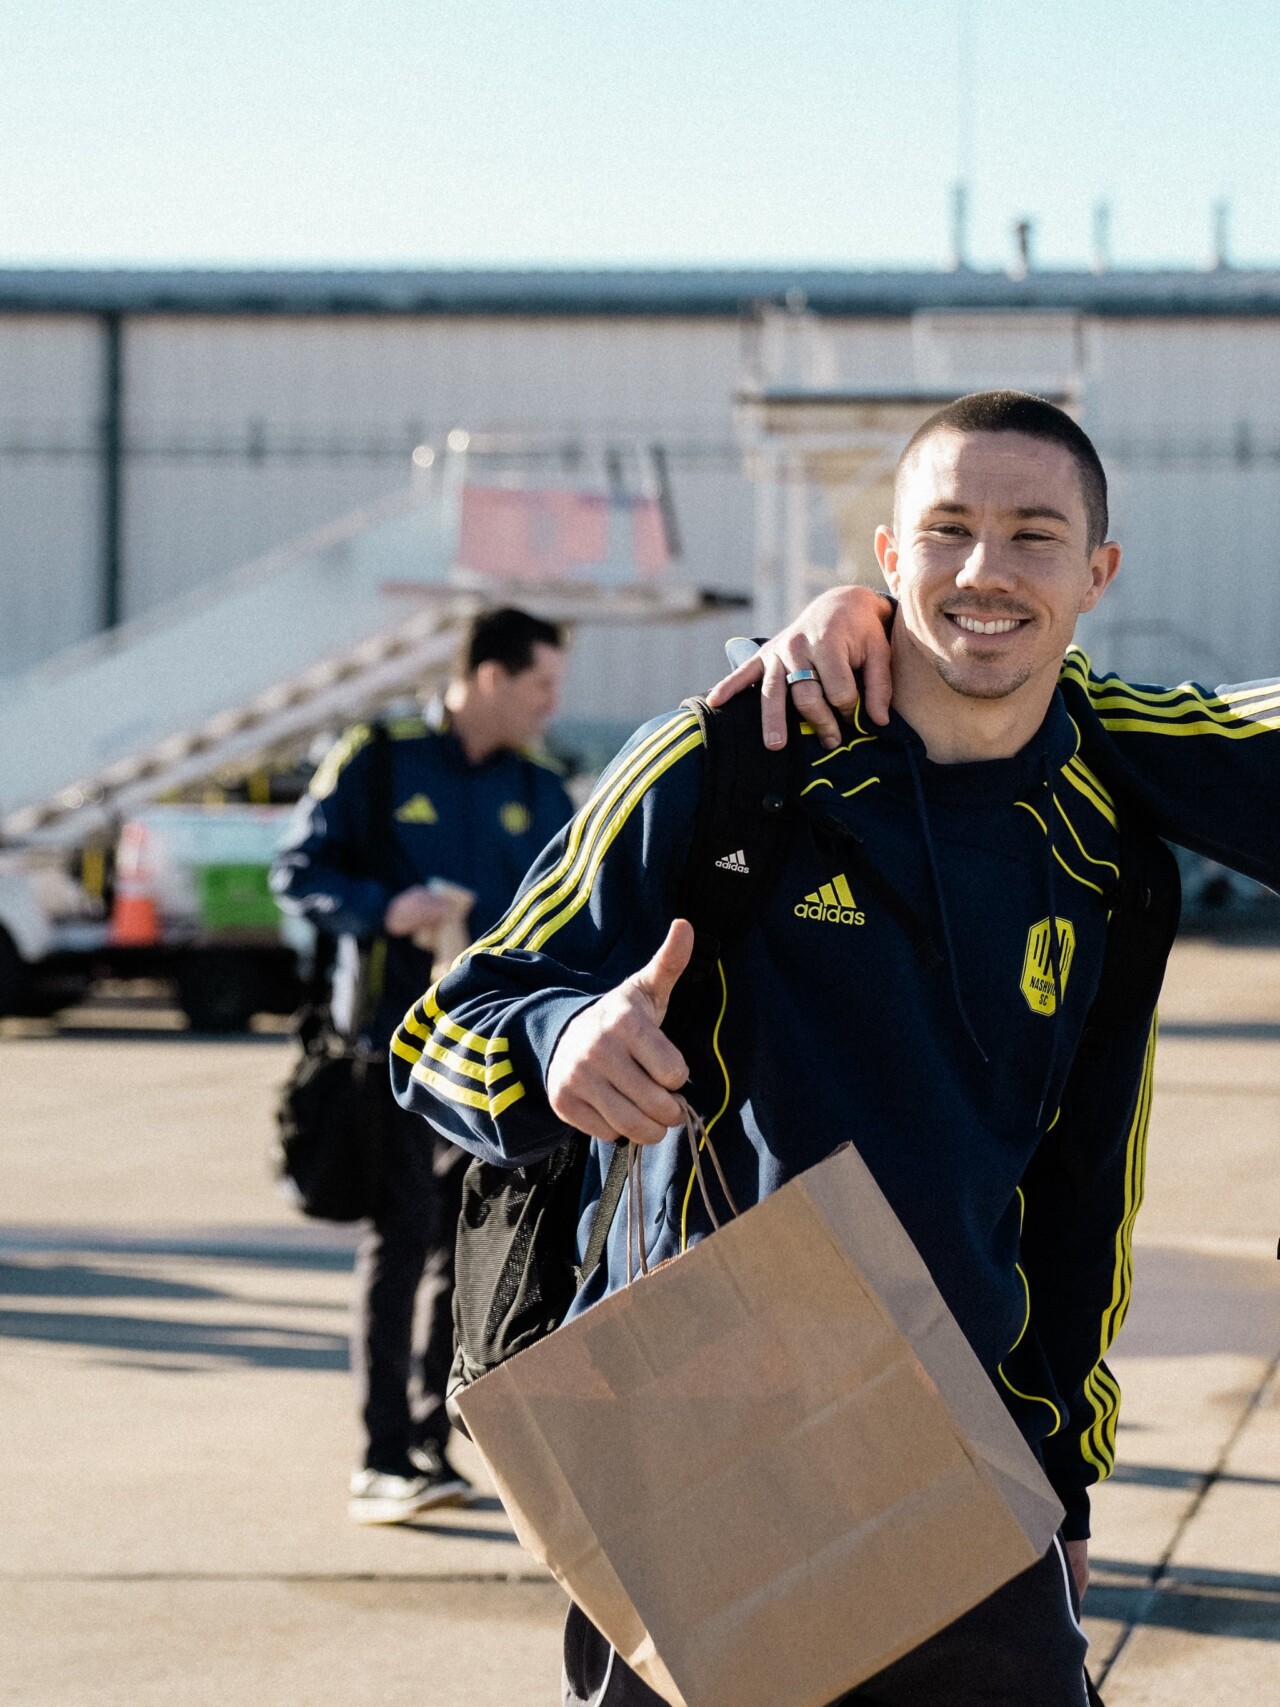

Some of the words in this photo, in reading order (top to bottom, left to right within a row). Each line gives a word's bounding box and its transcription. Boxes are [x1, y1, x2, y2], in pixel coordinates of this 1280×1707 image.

[715, 860, 750, 874] adidas
[794, 902, 865, 926] adidas
[1039, 993, 1048, 1006] SC
